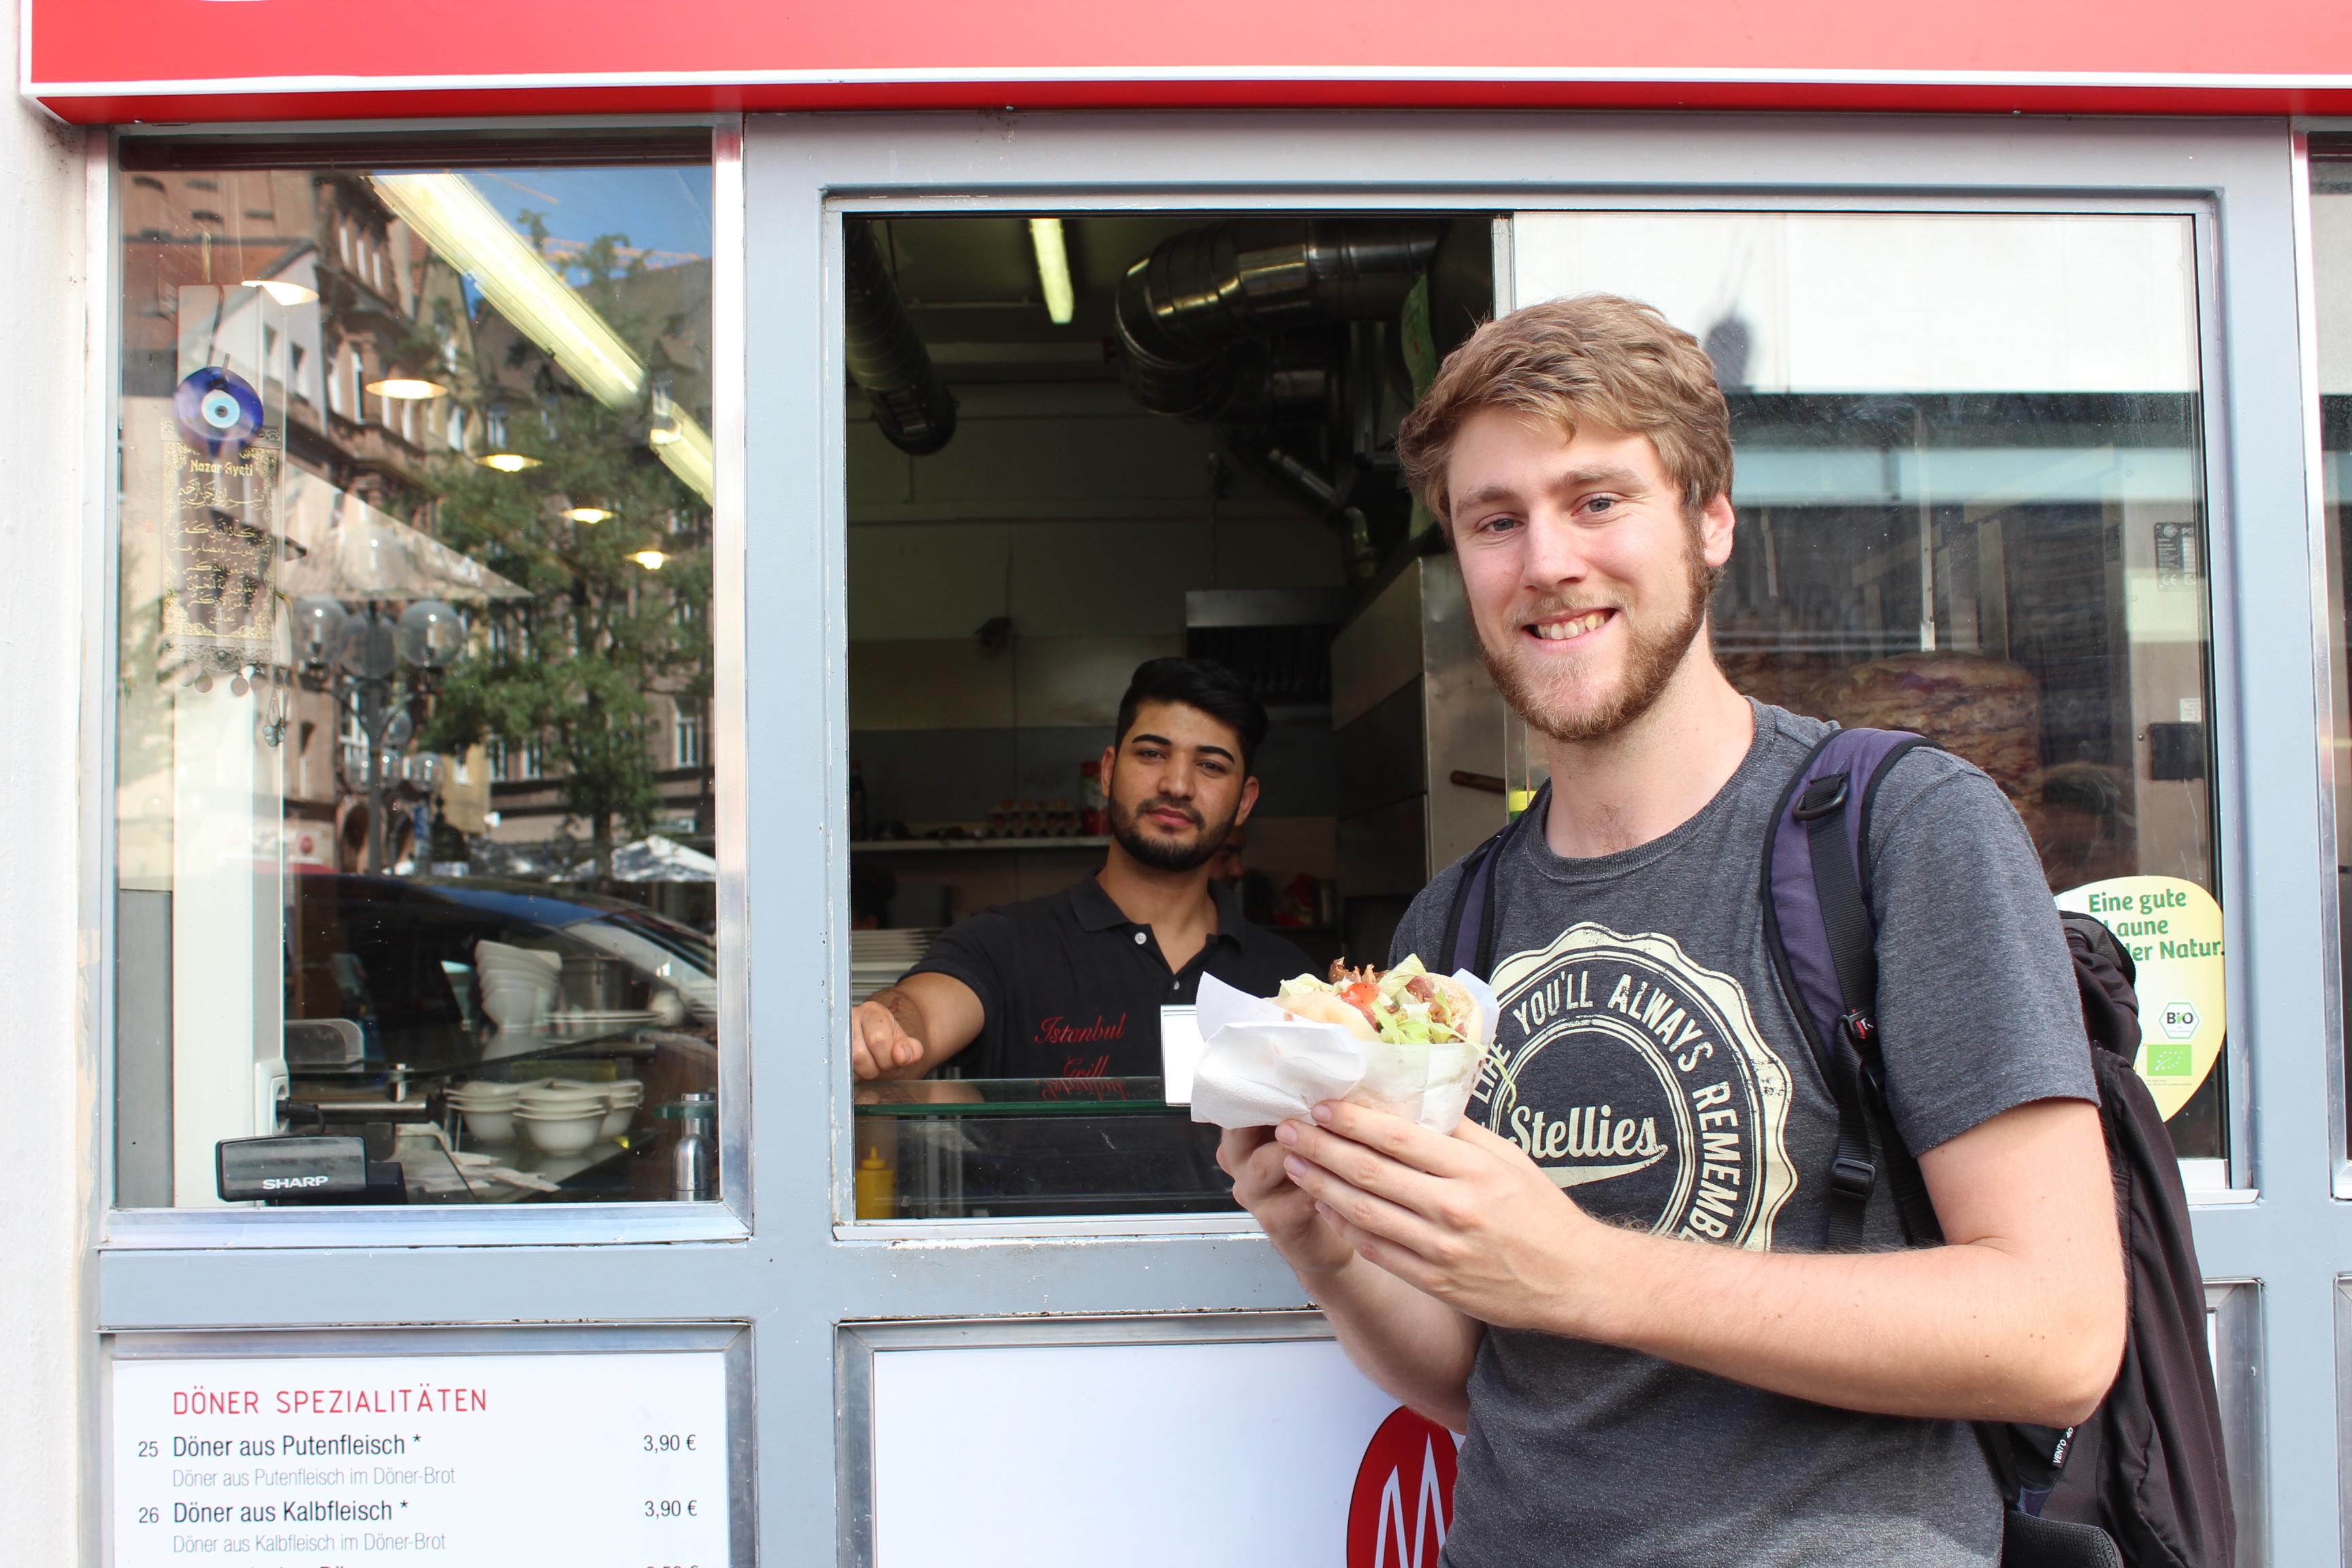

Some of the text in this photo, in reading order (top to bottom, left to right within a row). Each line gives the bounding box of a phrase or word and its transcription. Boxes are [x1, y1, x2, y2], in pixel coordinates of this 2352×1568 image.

[190, 460, 222, 474] Nazar
[2089, 889, 2187, 915] Eine gute
[2125, 942, 2153, 962] er
[1034, 1013, 1128, 1044] Istanbul
[1512, 970, 1593, 1036] YOU'LL
[1607, 973, 1713, 1073] ALWAYS
[1063, 1055, 1111, 1078] Grill
[1508, 1104, 1669, 1159] Stellies
[262, 1175, 329, 1190] SHARP
[174, 1383, 487, 1416] DÖNER SPEZIALITÄTEN
[138, 1441, 159, 1459] 25
[173, 1435, 233, 1458] Döner
[239, 1439, 275, 1457] aus
[282, 1434, 405, 1458] Putenfleisch
[643, 1434, 696, 1454] 3,90 €
[2053, 1426, 2074, 1464] VENTO 40
[173, 1467, 455, 1486] Döner aus Putenfleisch im Döner-Brot
[138, 1507, 159, 1524] 26
[174, 1501, 233, 1523] Döner
[240, 1506, 276, 1524] aus
[283, 1500, 392, 1522] Kalbfleisch
[644, 1499, 697, 1520] 3,90 €
[174, 1533, 445, 1553] Döner aus Kalbfleisch im Döner-Brot
